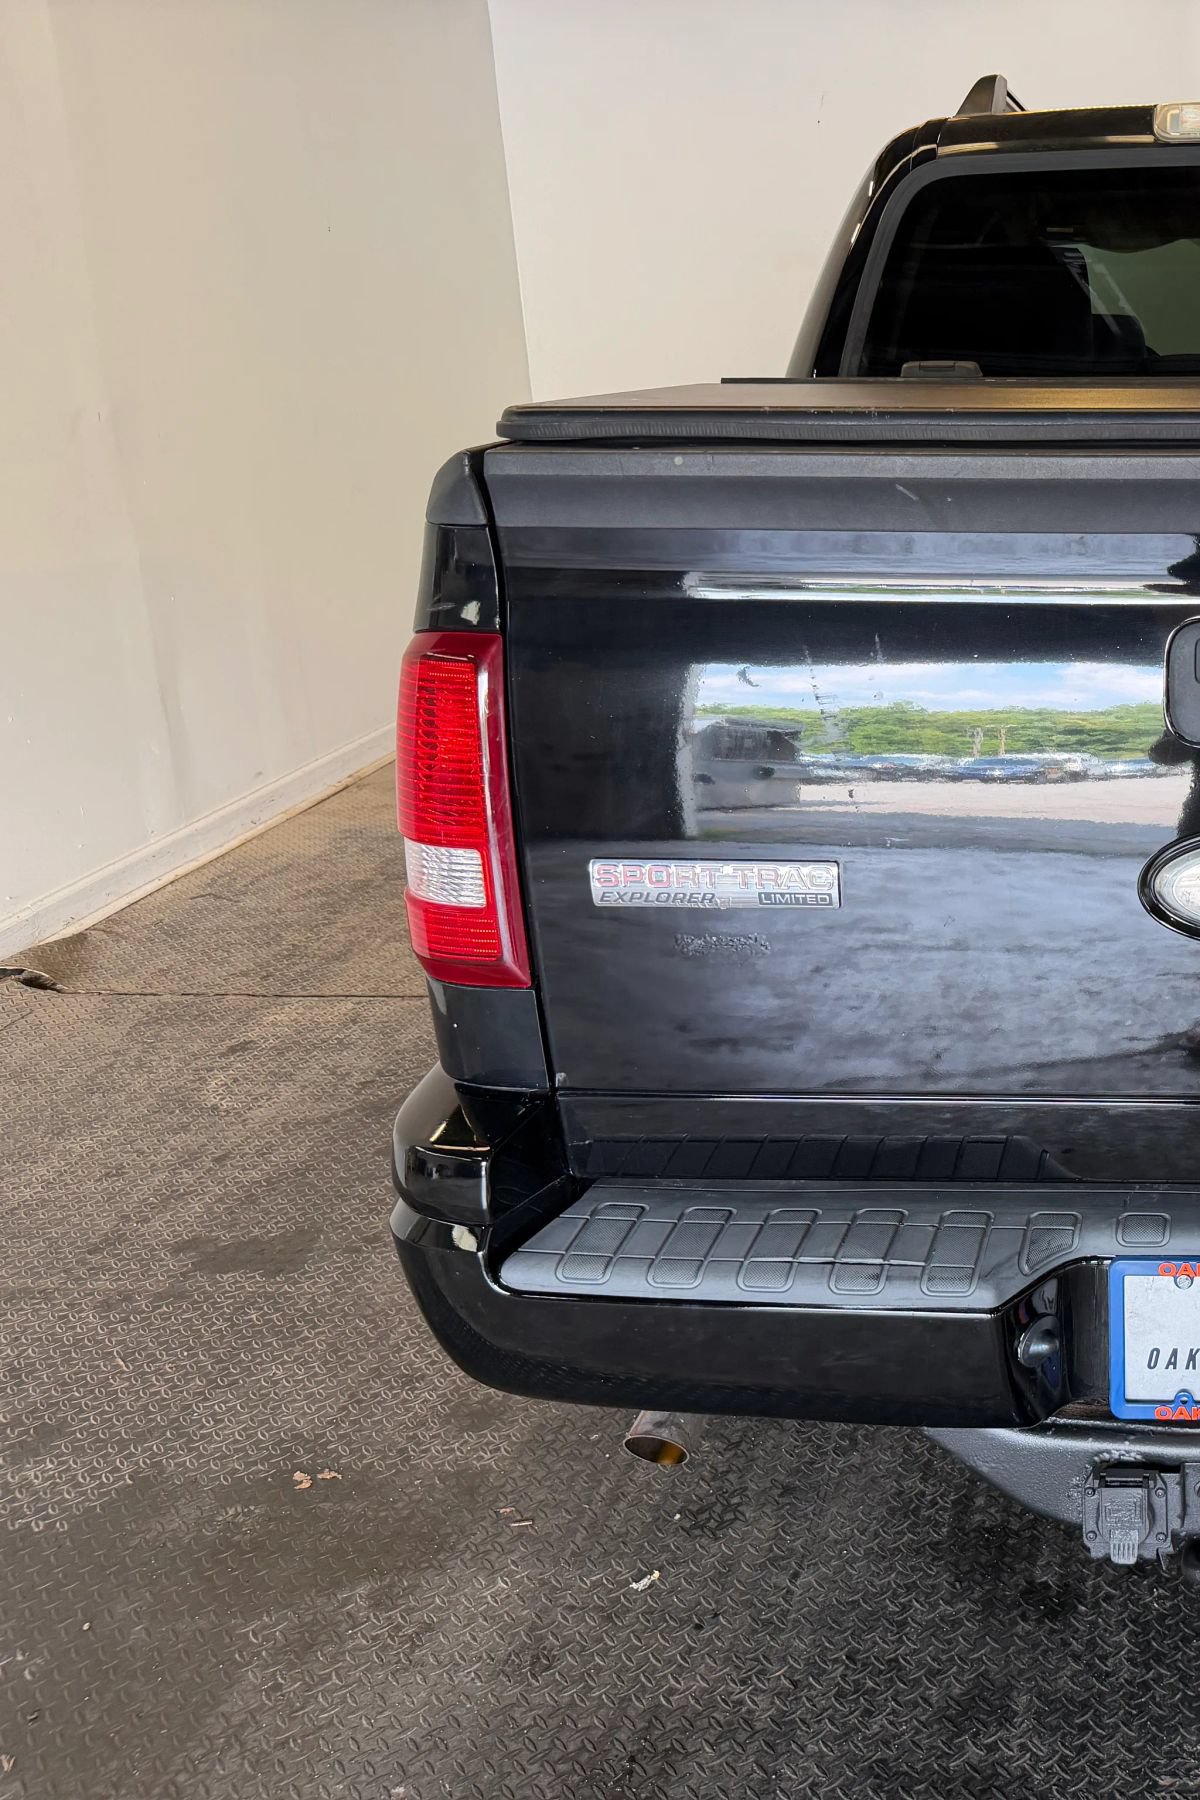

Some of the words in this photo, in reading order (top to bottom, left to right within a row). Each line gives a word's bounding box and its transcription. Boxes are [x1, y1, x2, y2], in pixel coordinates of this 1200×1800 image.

[594, 863, 722, 888] SPORT
[732, 864, 836, 890] TRAC
[600, 891, 716, 905] EXPLORER
[761, 892, 830, 905] LIMITED
